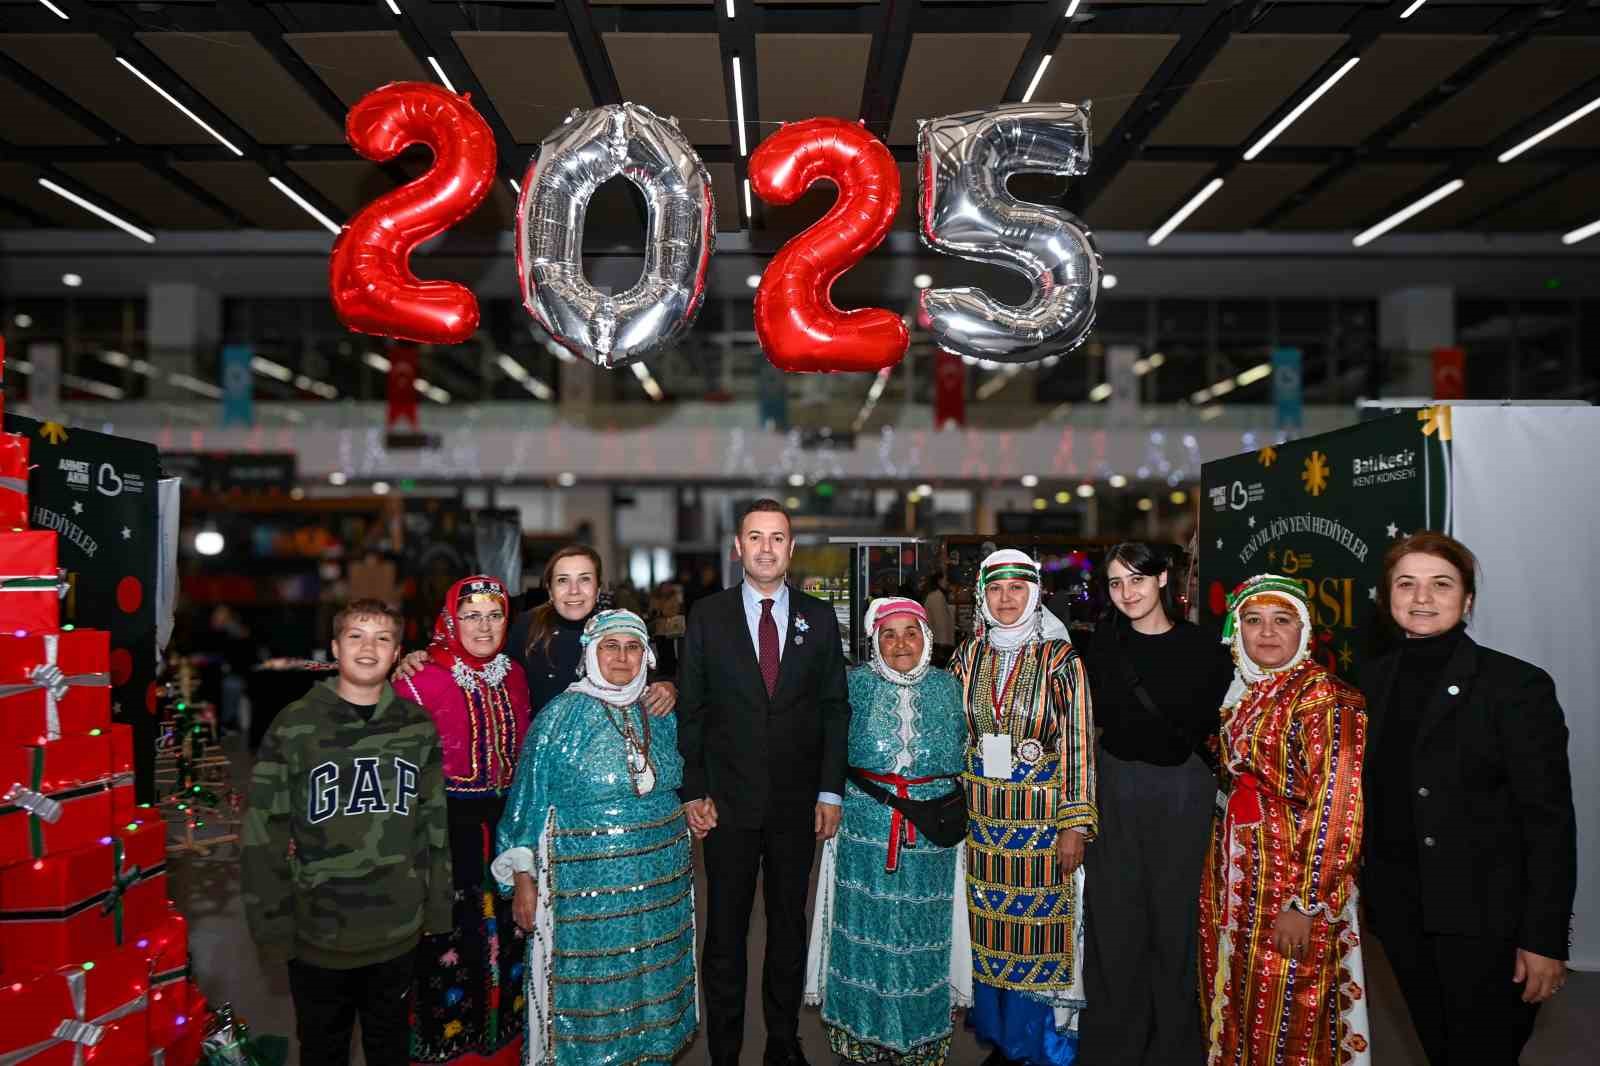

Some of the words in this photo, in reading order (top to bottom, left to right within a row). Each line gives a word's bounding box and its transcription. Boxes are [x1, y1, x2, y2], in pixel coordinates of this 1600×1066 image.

[329, 81, 1103, 374] 2025
[32, 505, 98, 558] HEDİYELER
[1289, 512, 1311, 533] YENİ
[1312, 517, 1369, 563] HEDİYELER
[307, 757, 420, 824] GAP
